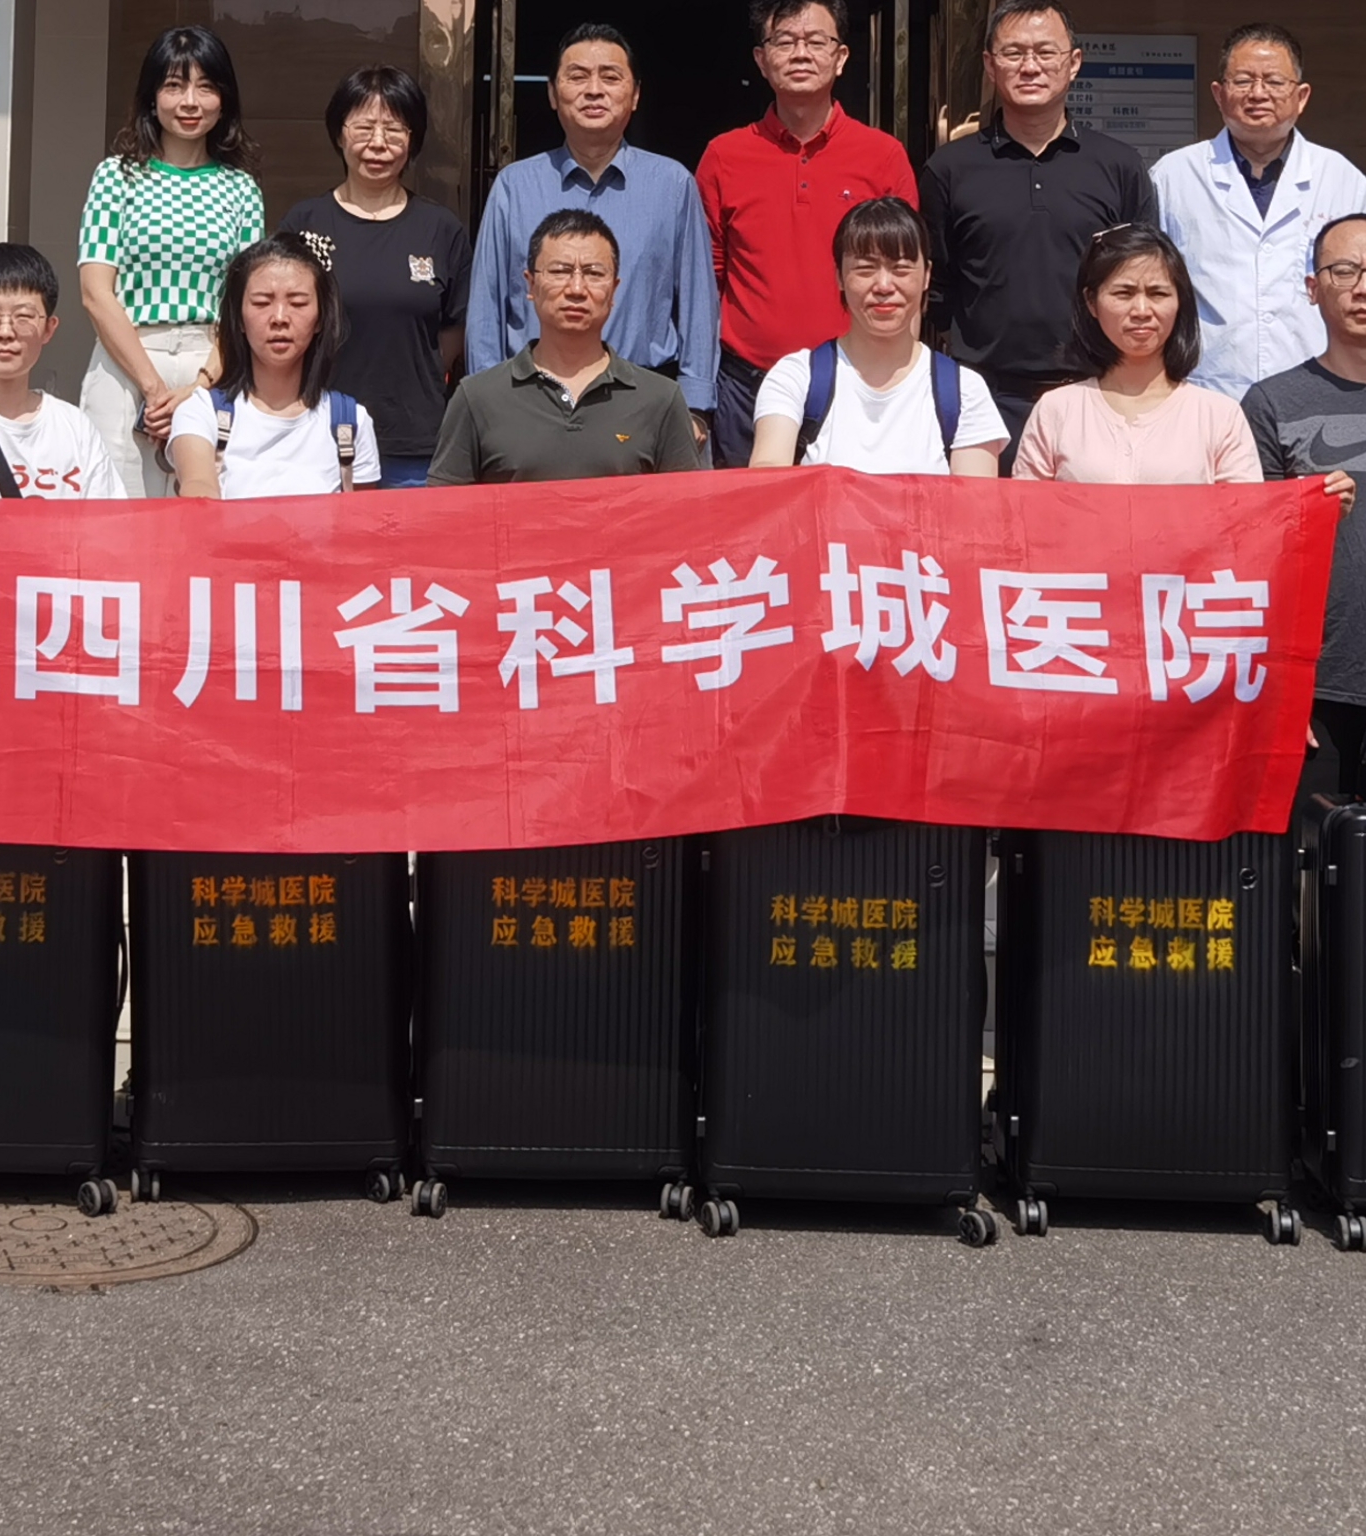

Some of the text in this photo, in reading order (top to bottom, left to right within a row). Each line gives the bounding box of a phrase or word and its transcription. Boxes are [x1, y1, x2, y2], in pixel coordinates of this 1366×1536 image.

[13, 543, 1271, 714] 四川省科学城医院
[191, 874, 337, 907] 科学城医院
[491, 876, 636, 908] 科学城医院
[192, 912, 337, 946] 应急救援
[770, 894, 919, 930] 科学城医院
[1088, 897, 1235, 933] 科学城医院
[491, 914, 636, 949] 应急救援
[770, 935, 919, 970] 应急救援
[1087, 935, 1235, 973] 应急救援
